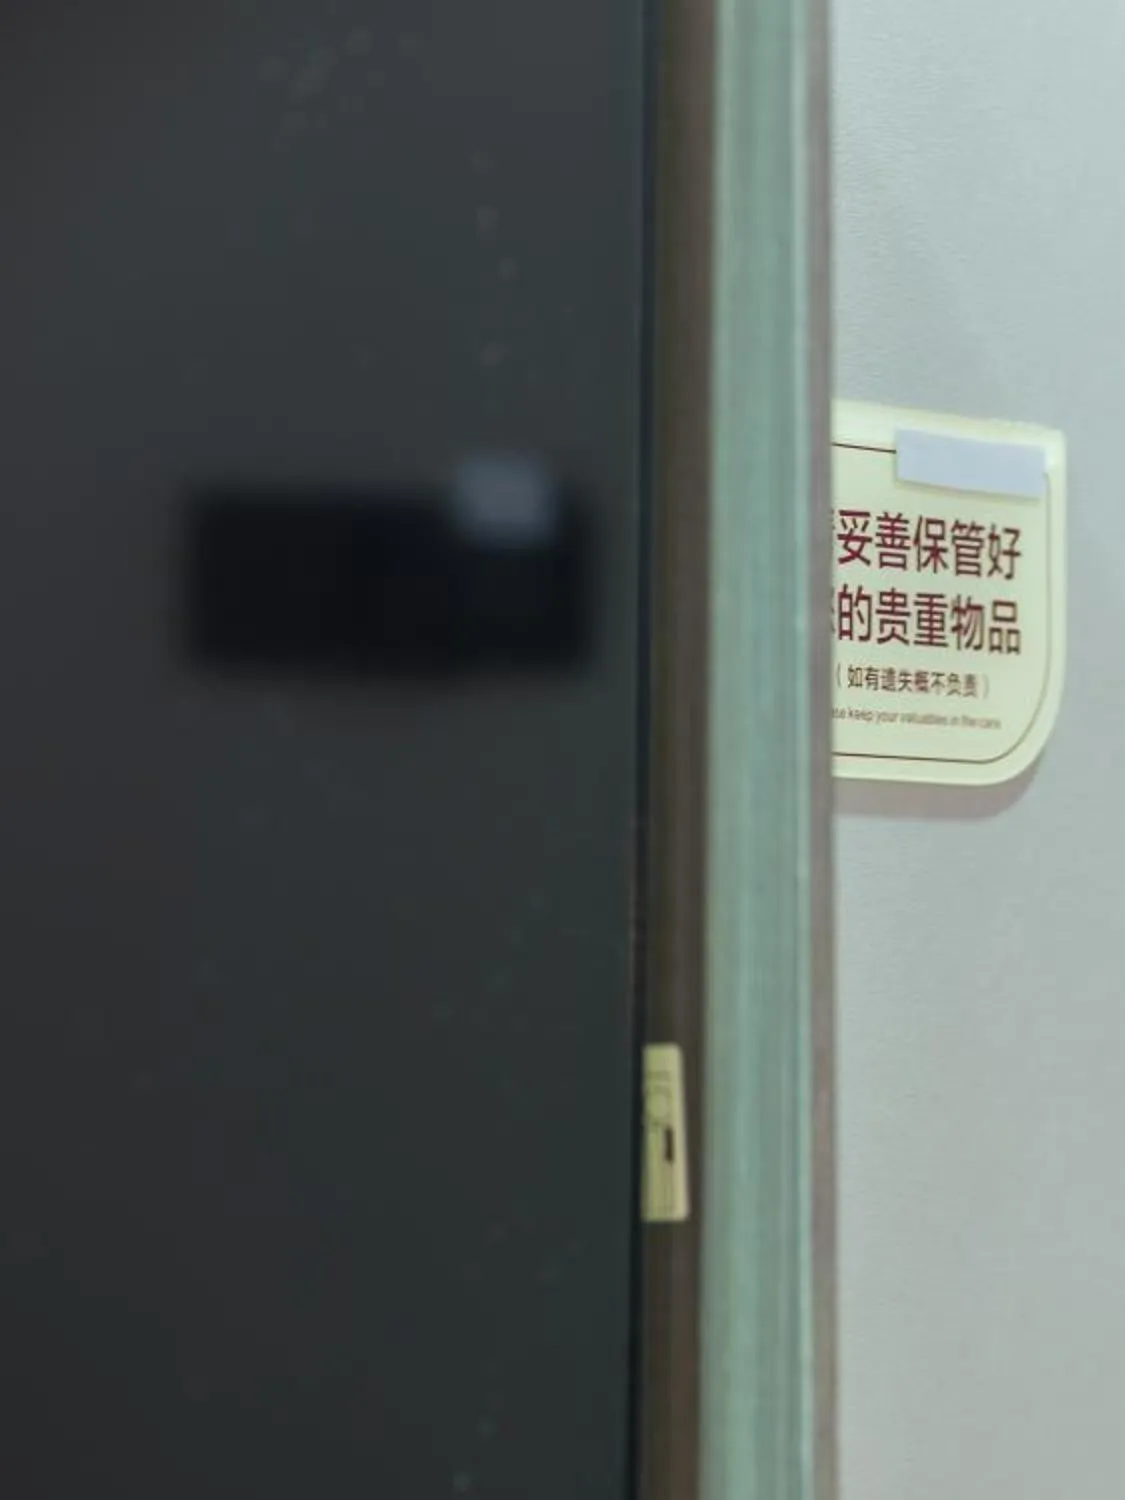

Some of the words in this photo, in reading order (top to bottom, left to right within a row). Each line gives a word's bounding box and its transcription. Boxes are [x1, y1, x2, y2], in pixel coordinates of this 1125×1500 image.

[832, 509, 1022, 580] 妥善保管好
[832, 584, 1022, 655] 的贵重物品
